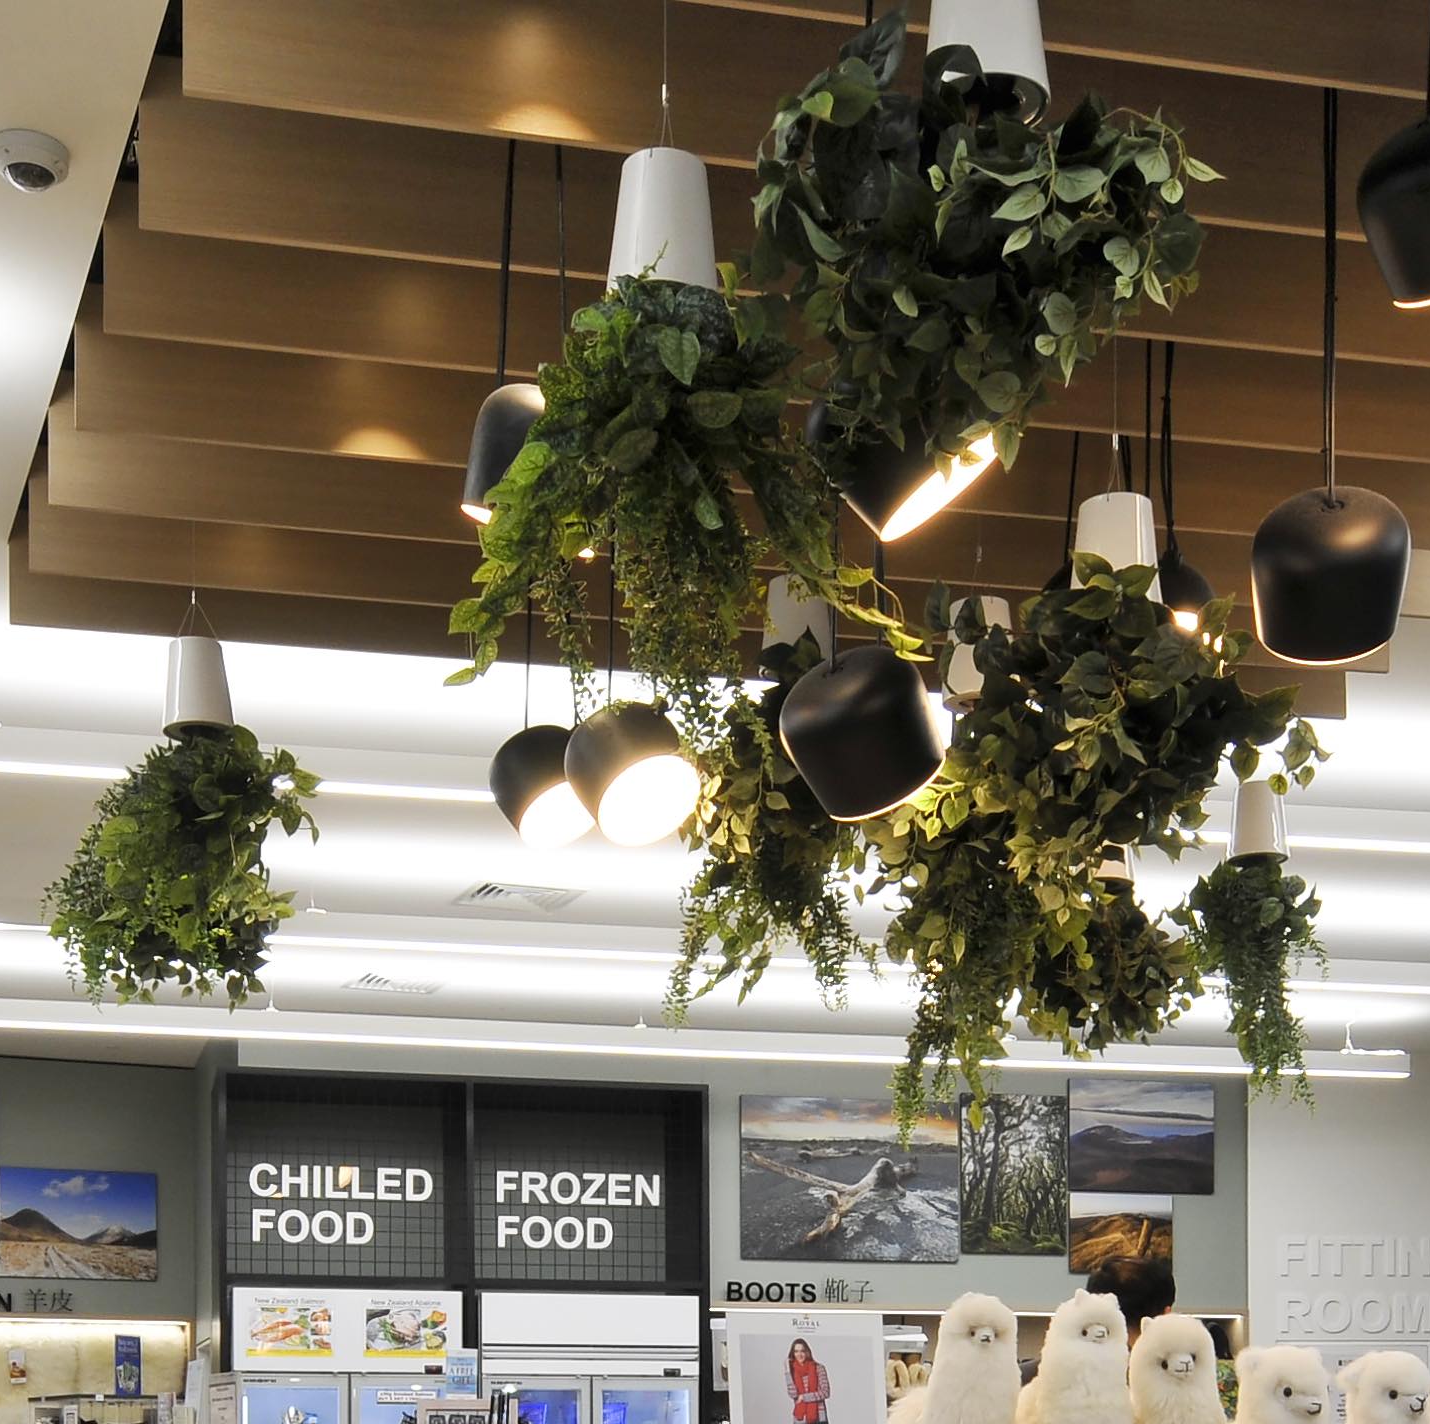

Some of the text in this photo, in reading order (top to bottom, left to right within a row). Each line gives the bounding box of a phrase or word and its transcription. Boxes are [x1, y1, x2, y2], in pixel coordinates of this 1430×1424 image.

[249, 1163, 433, 1201] CHILLED
[496, 1170, 660, 1206] FROZEN
[252, 1208, 374, 1245] FOOD
[497, 1215, 613, 1250] FOOD
[25, 1288, 73, 1312] 羊皮
[726, 1281, 817, 1303] BOOTS
[825, 1278, 874, 1303] 靴子
